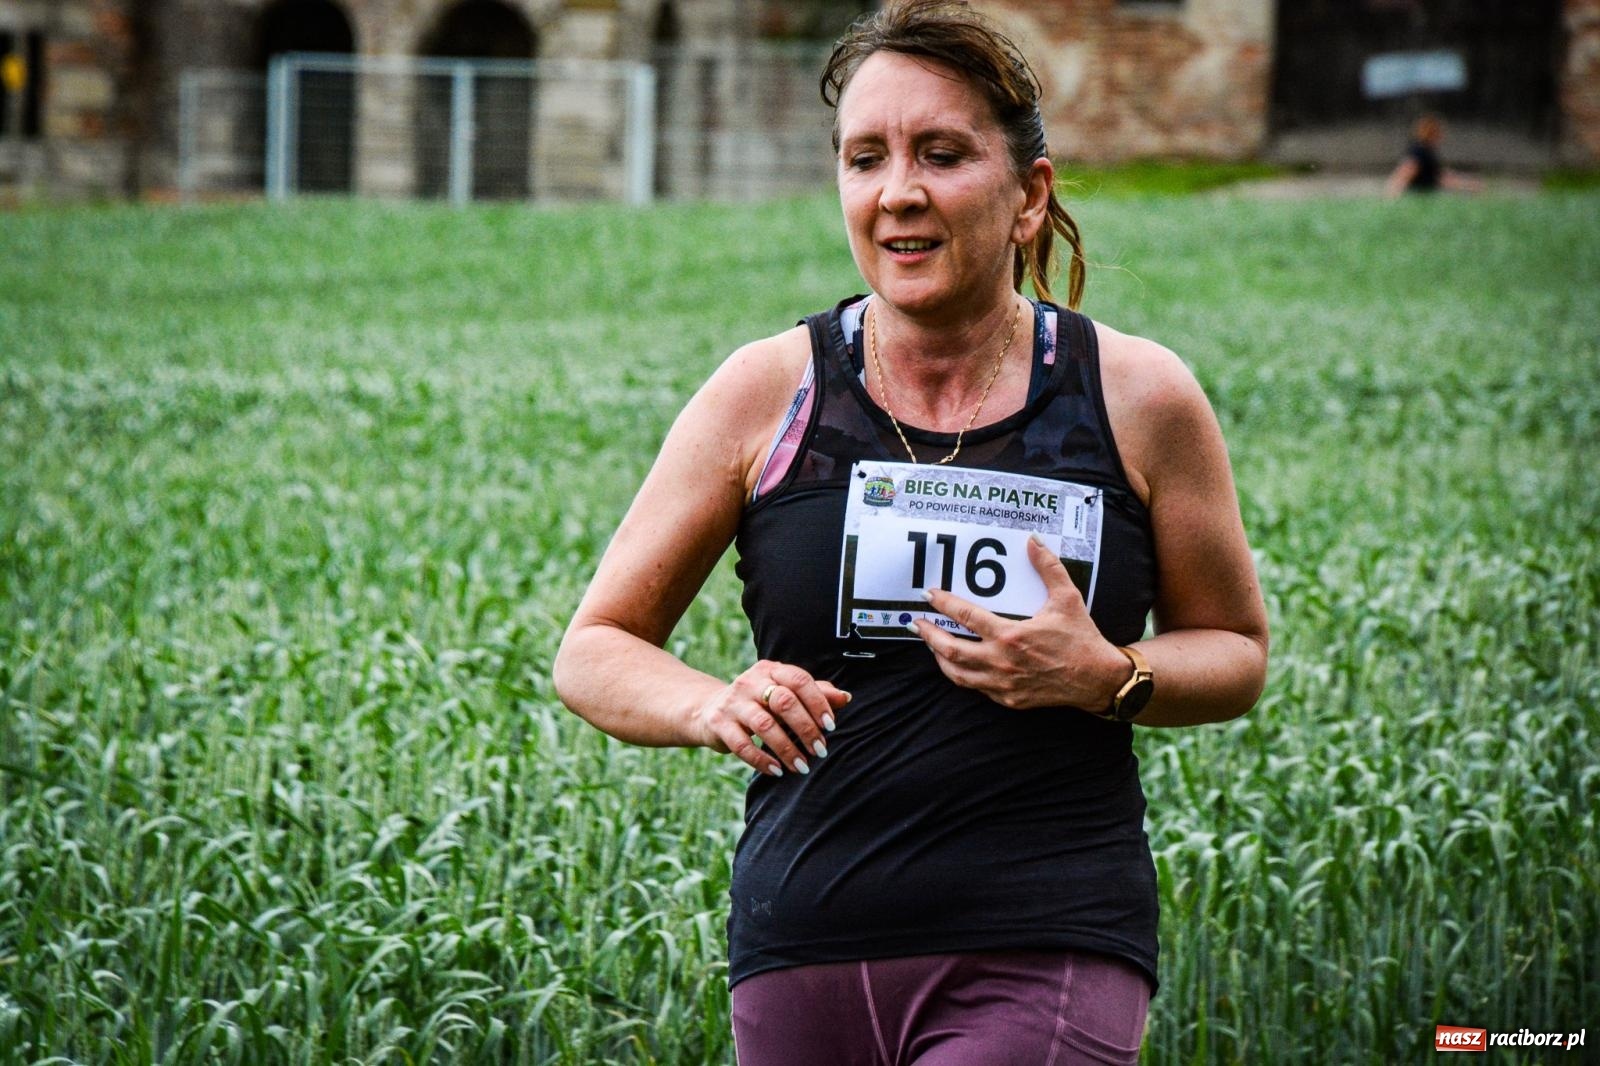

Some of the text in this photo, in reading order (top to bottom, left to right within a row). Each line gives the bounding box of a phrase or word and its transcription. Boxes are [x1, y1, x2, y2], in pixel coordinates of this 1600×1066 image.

[904, 479, 1058, 514] BIEG NA PIĄTKĘ
[909, 500, 1050, 524] PO POWIECIE RACIBORSKIM
[907, 531, 1007, 598] 116
